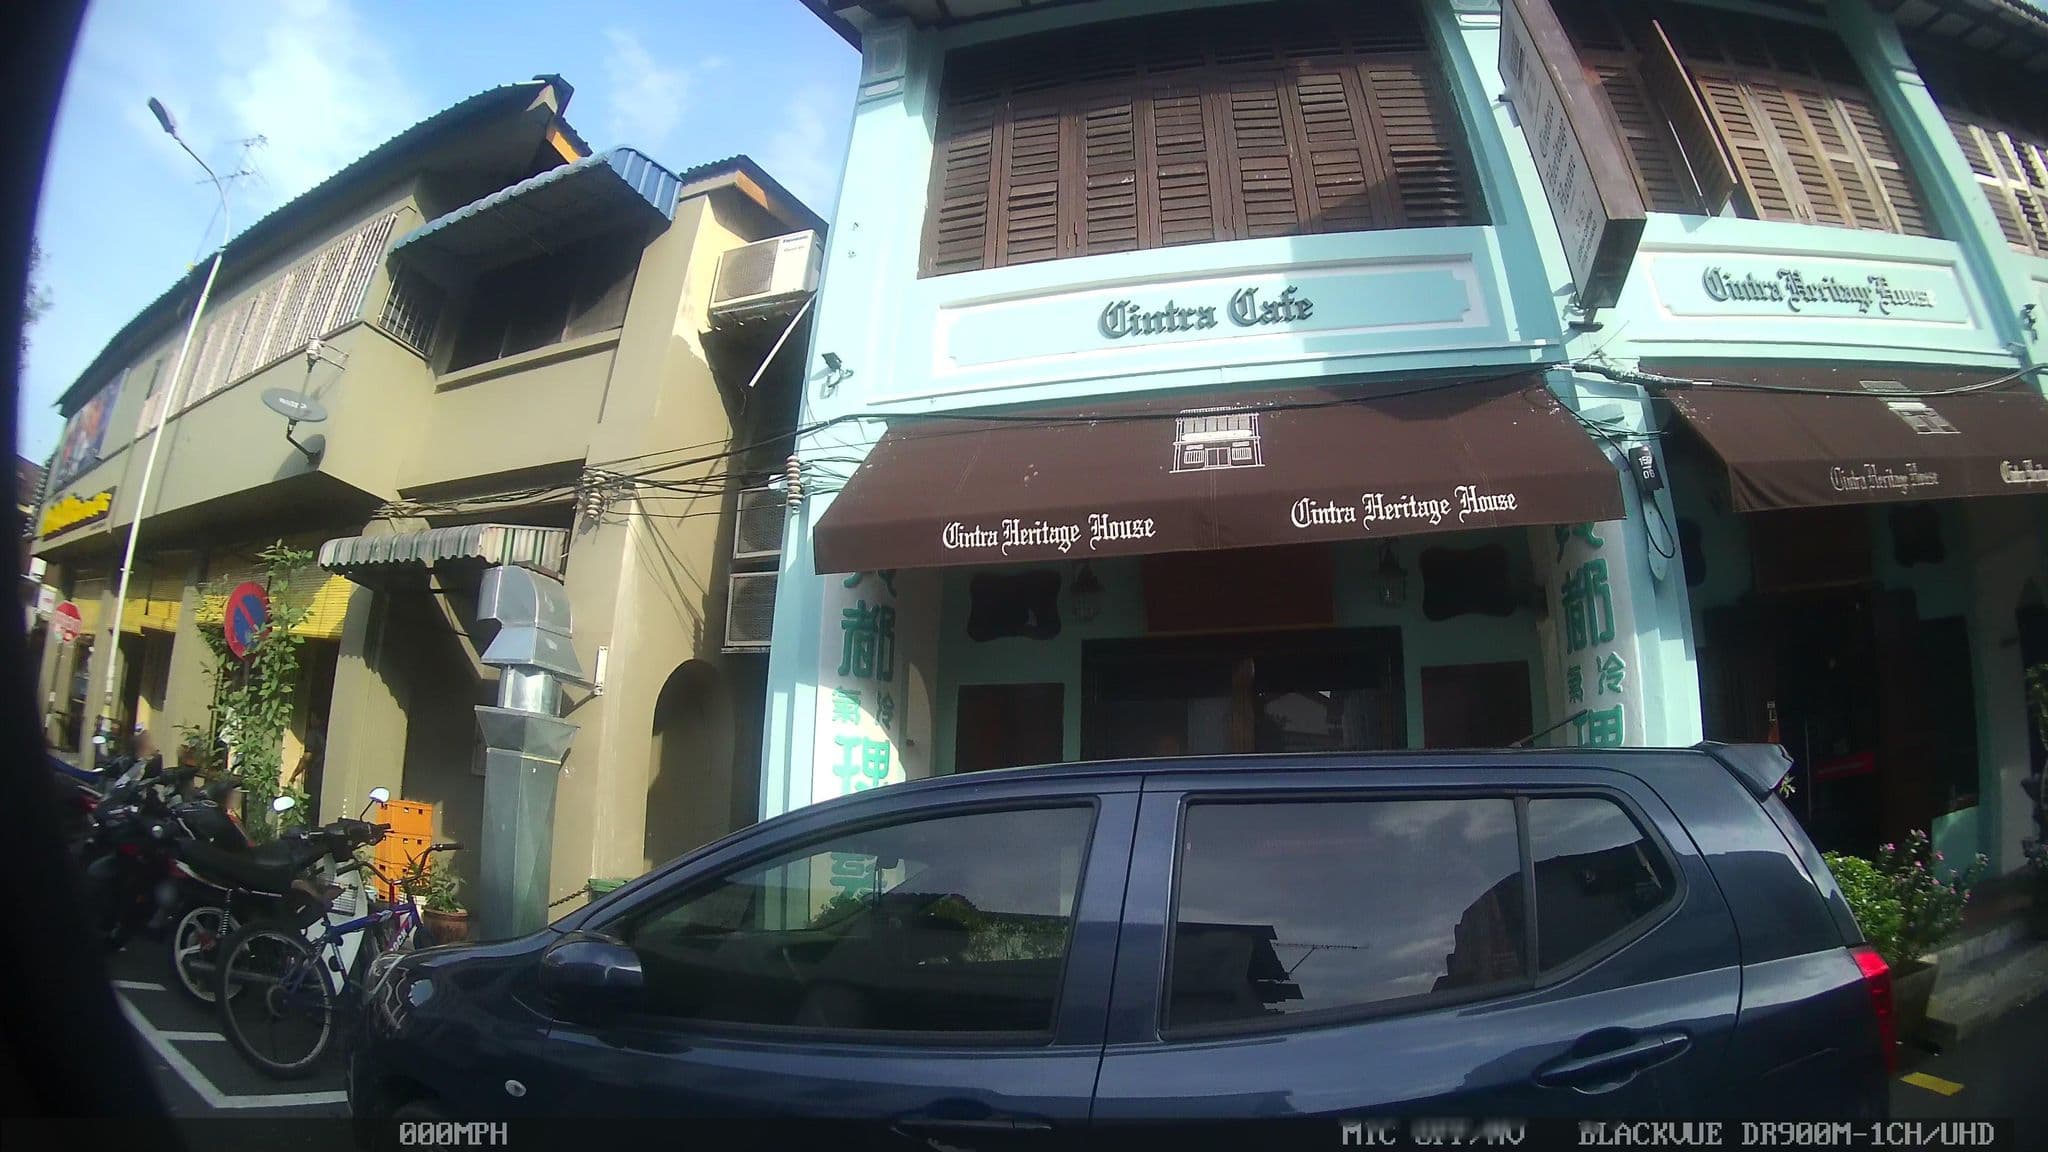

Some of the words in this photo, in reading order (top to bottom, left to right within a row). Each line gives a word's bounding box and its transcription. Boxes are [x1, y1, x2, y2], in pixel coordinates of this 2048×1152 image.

[1098, 299, 1218, 339] Cintra
[1227, 285, 1314, 328] Cafe
[1702, 266, 1784, 303] Cintra
[1776, 267, 1873, 313] Heritage
[1830, 465, 1867, 491] Cintra
[1290, 497, 1356, 528] Cintra
[1361, 493, 1451, 530] Heritage
[1454, 485, 1518, 523] House
[942, 521, 998, 549] Cintra
[1001, 518, 1081, 556] Heritage
[1088, 513, 1156, 550] House
